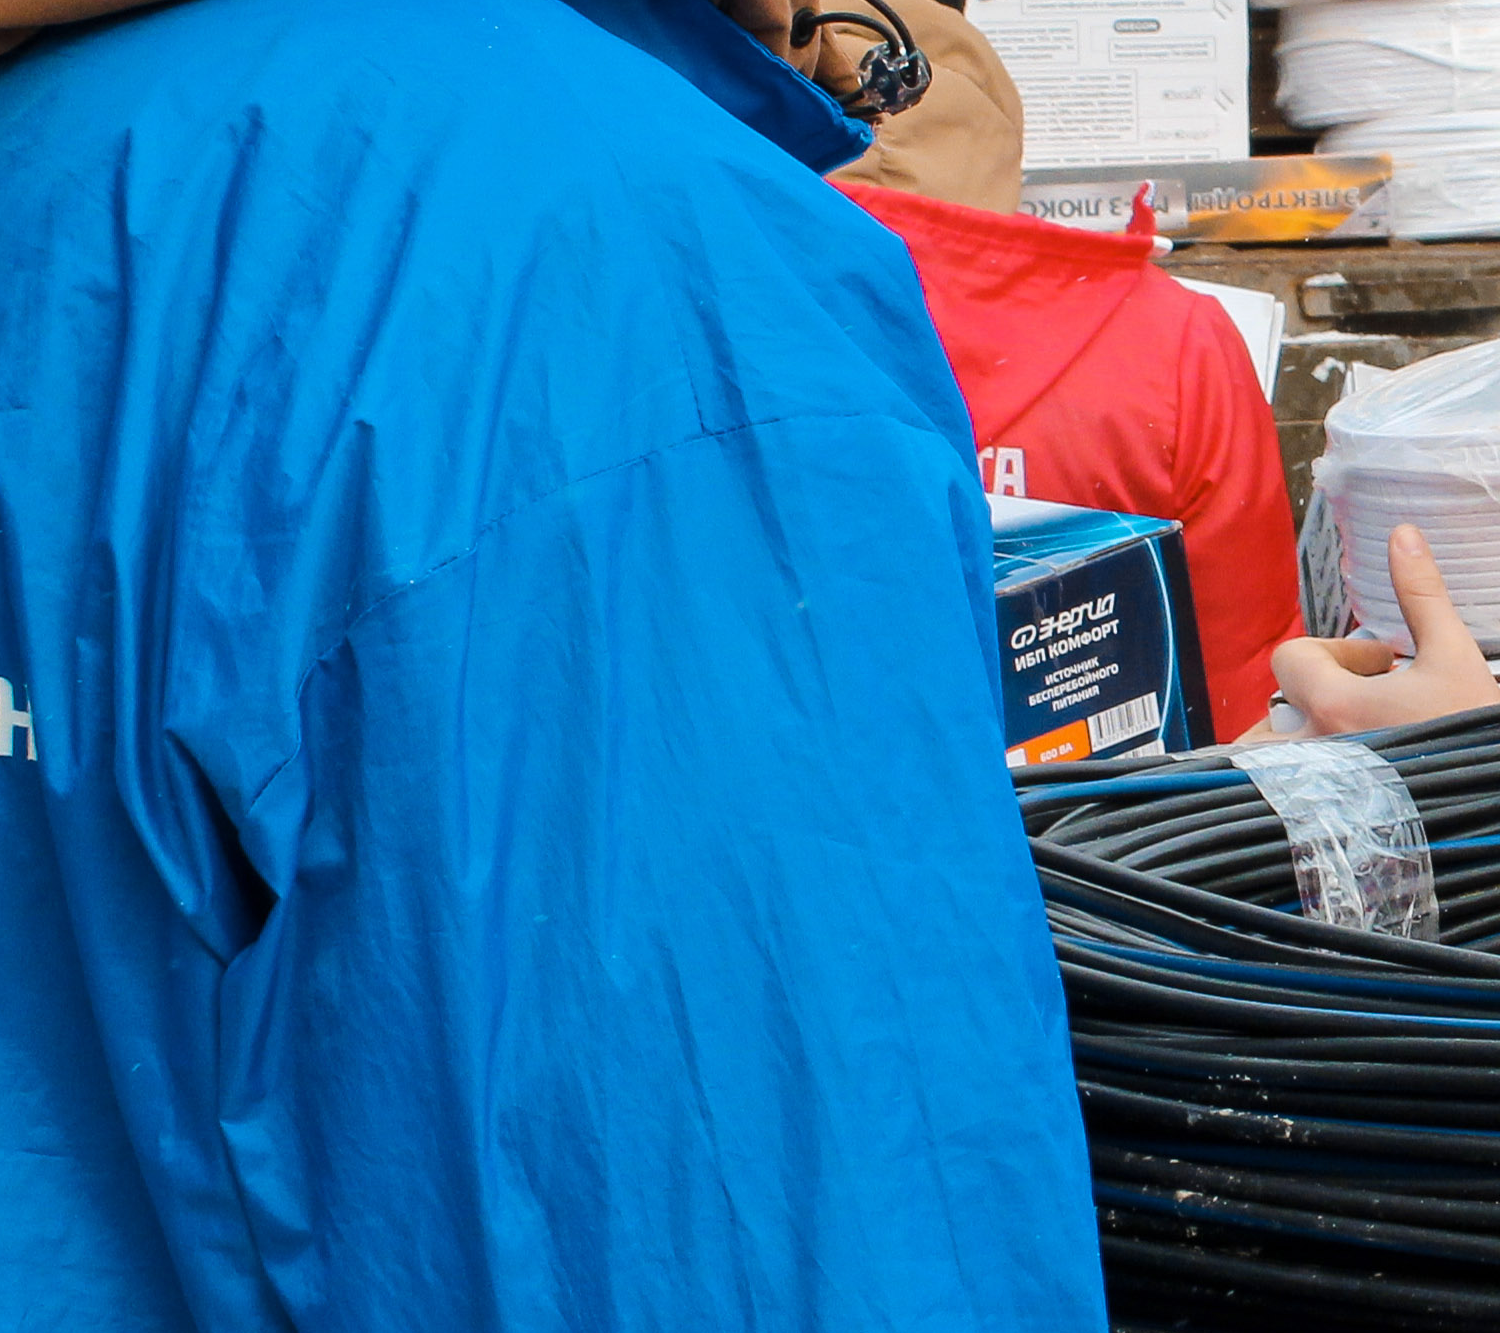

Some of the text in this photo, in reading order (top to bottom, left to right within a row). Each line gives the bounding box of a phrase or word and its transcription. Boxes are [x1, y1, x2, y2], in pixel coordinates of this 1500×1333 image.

[1109, 193, 1170, 218] М-3
[1186, 186, 1360, 214] ЭЛЕКТРОДЫ
[1013, 619, 1121, 673] ИБП КОМФОРТ
[1027, 662, 1120, 708] БЕСПЕРЕБОЙНОГО
[1044, 655, 1100, 687] ИСТОЧНИК
[1051, 684, 1100, 713] ПИТАНИЯ
[1039, 747, 1059, 763] 600
